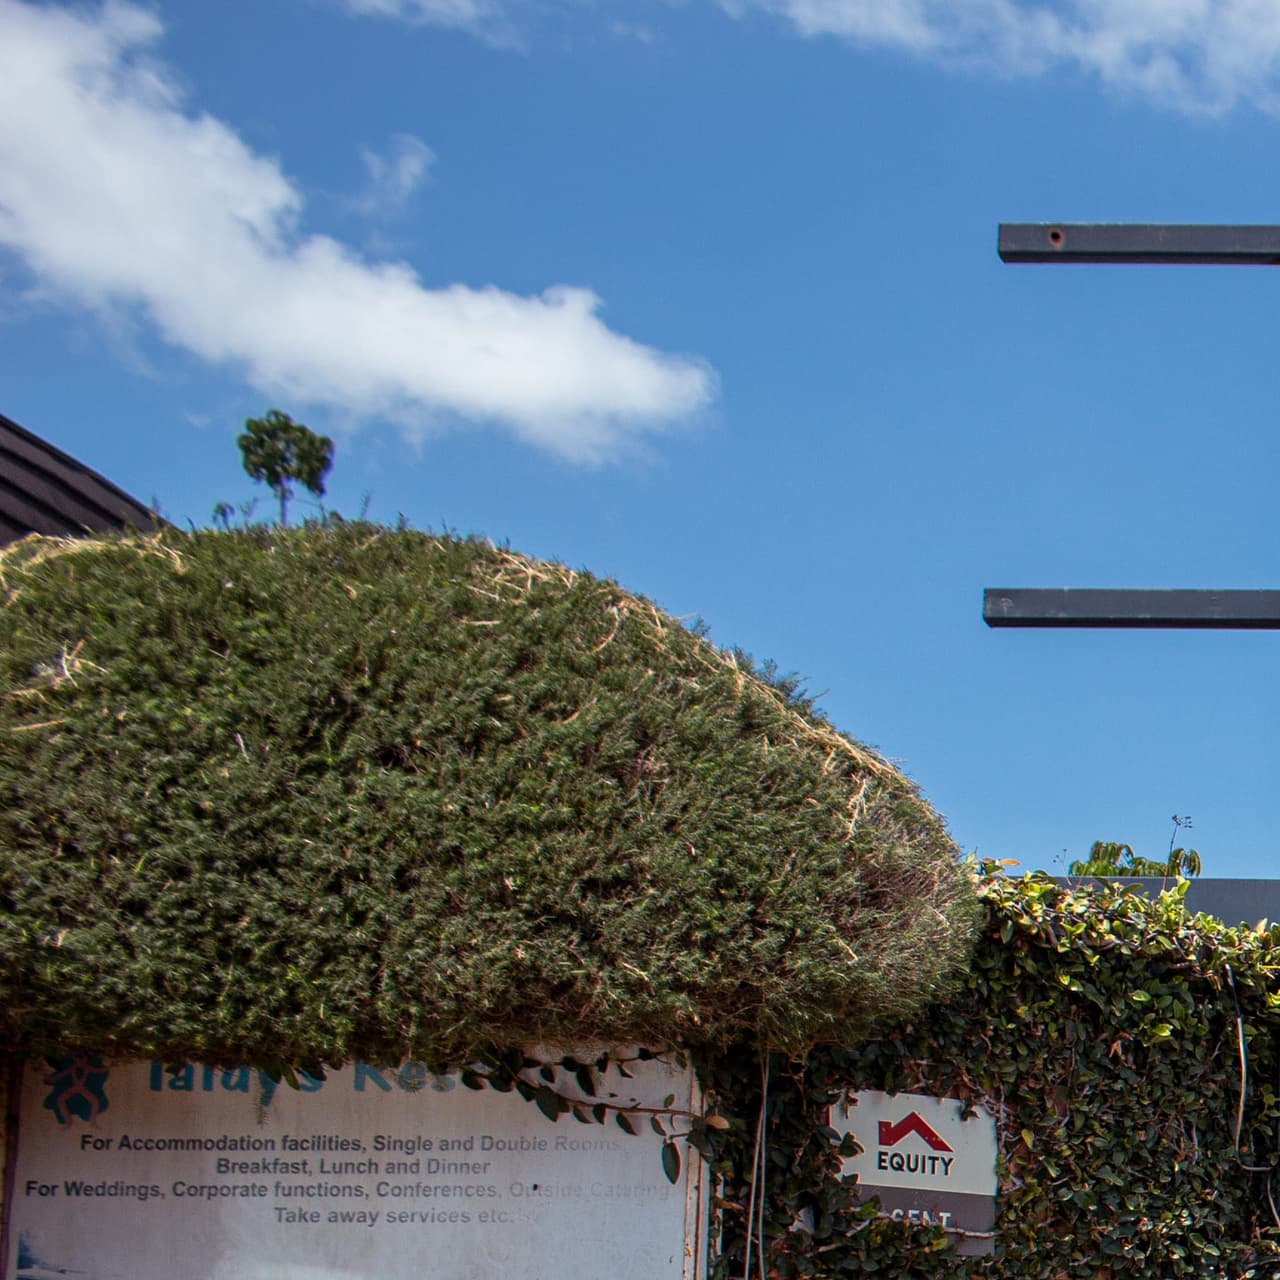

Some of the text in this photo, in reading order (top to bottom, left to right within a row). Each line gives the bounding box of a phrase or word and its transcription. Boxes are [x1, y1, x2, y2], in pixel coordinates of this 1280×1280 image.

[81, 1135, 111, 1151] For
[118, 1135, 275, 1151] Accommodation
[281, 1135, 367, 1154] facilities,
[373, 1135, 434, 1155] Single
[439, 1136, 474, 1151] and
[481, 1136, 548, 1151] Double
[216, 1158, 491, 1177] Breakfast, Lunch and Dinner
[878, 1151, 954, 1176] EQUITY
[25, 1180, 59, 1197] For
[64, 1181, 165, 1201] Weddings,
[172, 1181, 268, 1201] Corporate
[274, 1181, 370, 1200] functions,
[274, 1207, 321, 1223] Take
[328, 1210, 379, 1227] away
[386, 1208, 471, 1224] services
